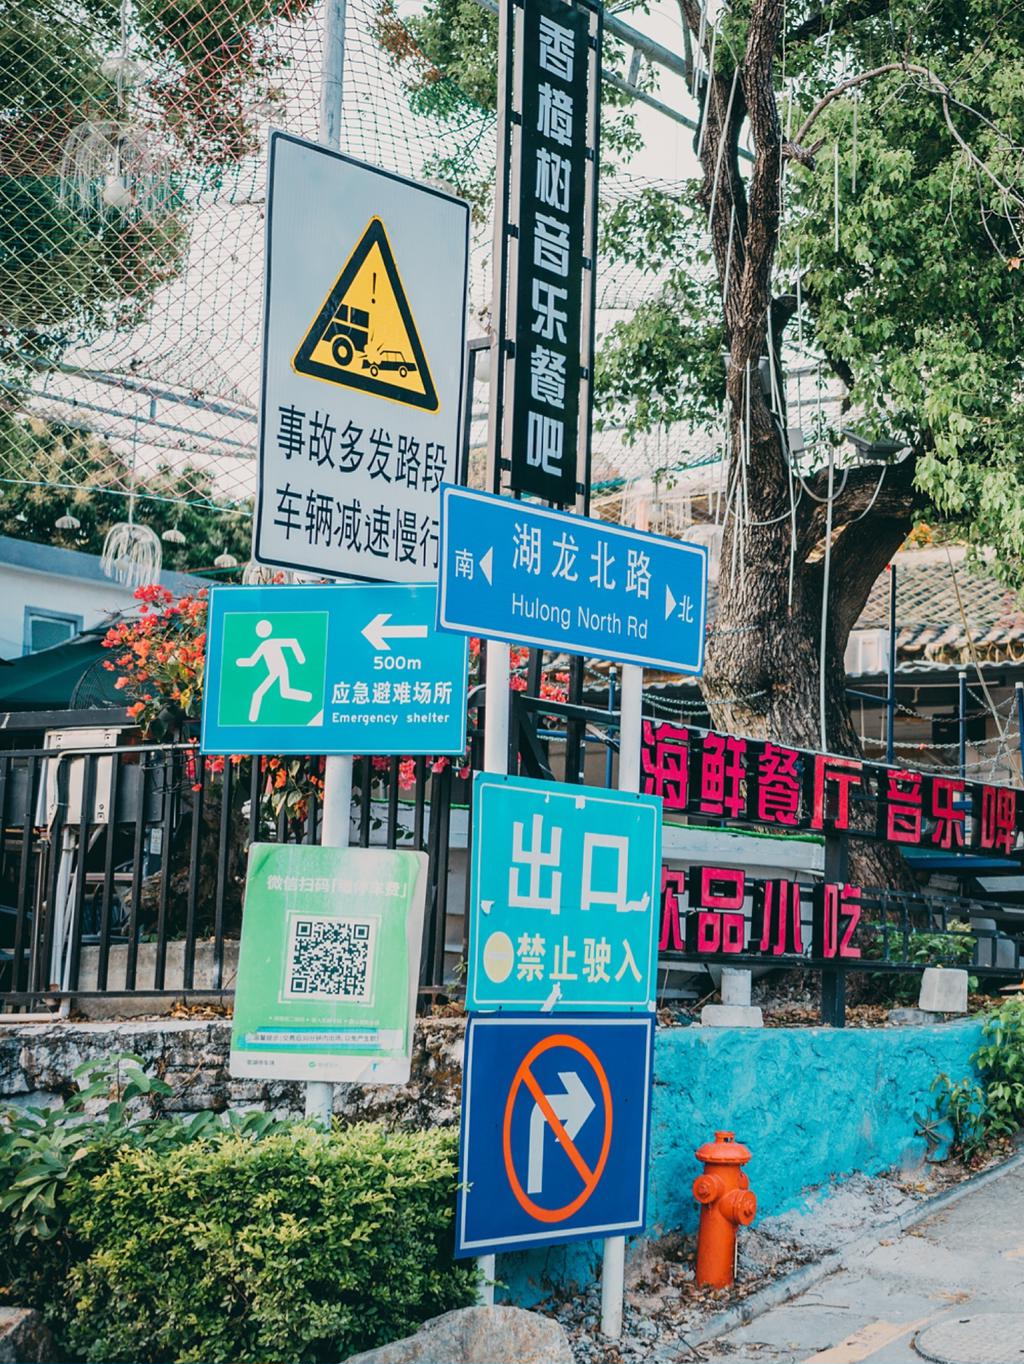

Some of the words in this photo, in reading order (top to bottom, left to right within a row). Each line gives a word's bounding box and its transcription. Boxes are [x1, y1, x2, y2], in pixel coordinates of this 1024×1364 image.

[526, 14, 575, 477] 香樟树音乐餐吧
[277, 404, 447, 493] 事故多发路段
[274, 482, 440, 569] 车辆减速慢行
[454, 548, 474, 581] 南
[512, 523, 652, 600] 湖龙北路
[512, 593, 571, 630] Hulong
[578, 606, 621, 635] North
[627, 616, 648, 639] Rd
[677, 595, 694, 624] 北
[373, 656, 422, 670] 500m
[331, 681, 453, 705] 应急避难场所
[332, 712, 399, 725] Emergency
[406, 712, 450, 723] shelter
[642, 720, 863, 832] 海鲜餐厅
[508, 813, 630, 915] 出口
[516, 932, 643, 983] 禁止驶入
